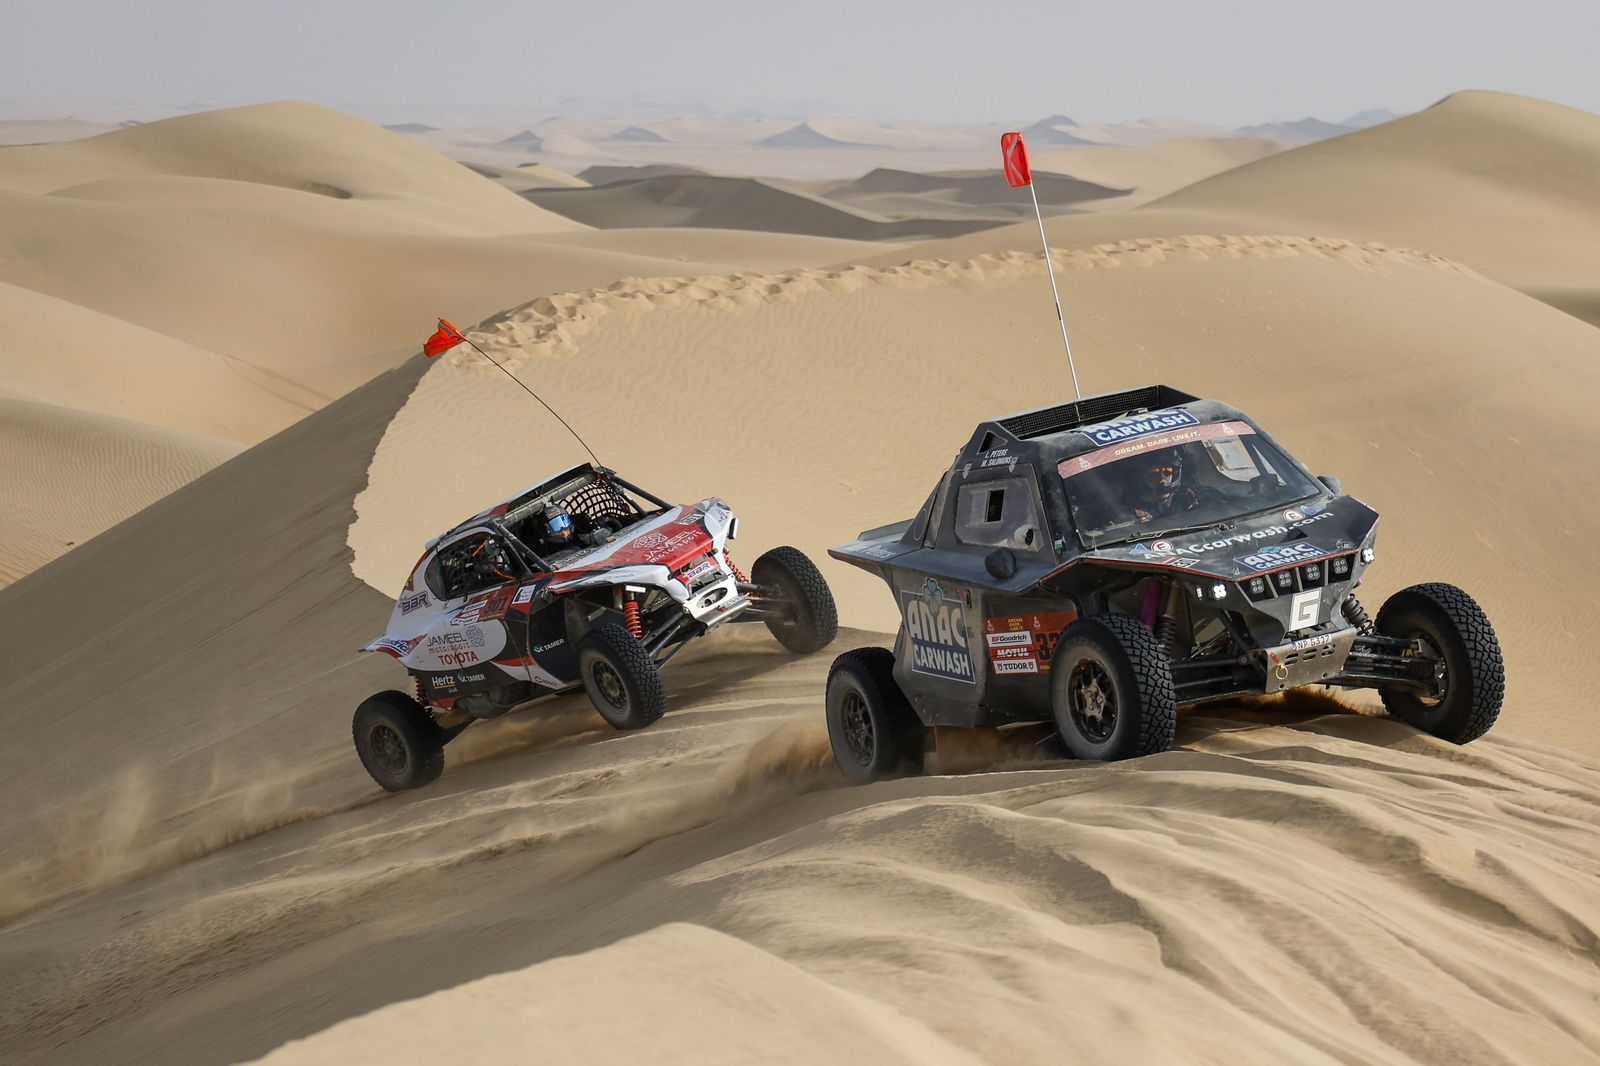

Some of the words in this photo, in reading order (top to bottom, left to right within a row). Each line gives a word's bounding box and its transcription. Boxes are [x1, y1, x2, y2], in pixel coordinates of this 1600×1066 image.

[1095, 413, 1190, 441] CARWASH
[1172, 433, 1190, 441] LIVE
[990, 449, 1009, 458] PETERS
[1143, 511, 1335, 560] ANACcarwash.com
[644, 530, 696, 560] JAMEEL
[1255, 549, 1325, 569] CARWASH
[427, 632, 467, 647] JAMEEL
[544, 638, 565, 651] TAMER
[429, 642, 471, 654] motorsport
[997, 648, 1029, 658] MOTUL
[438, 651, 480, 666] TOYOTA
[913, 643, 971, 676] CARWASH
[1003, 662, 1028, 671] TUDOR
[431, 675, 455, 686] Hertz
[466, 674, 486, 682] TAMER
